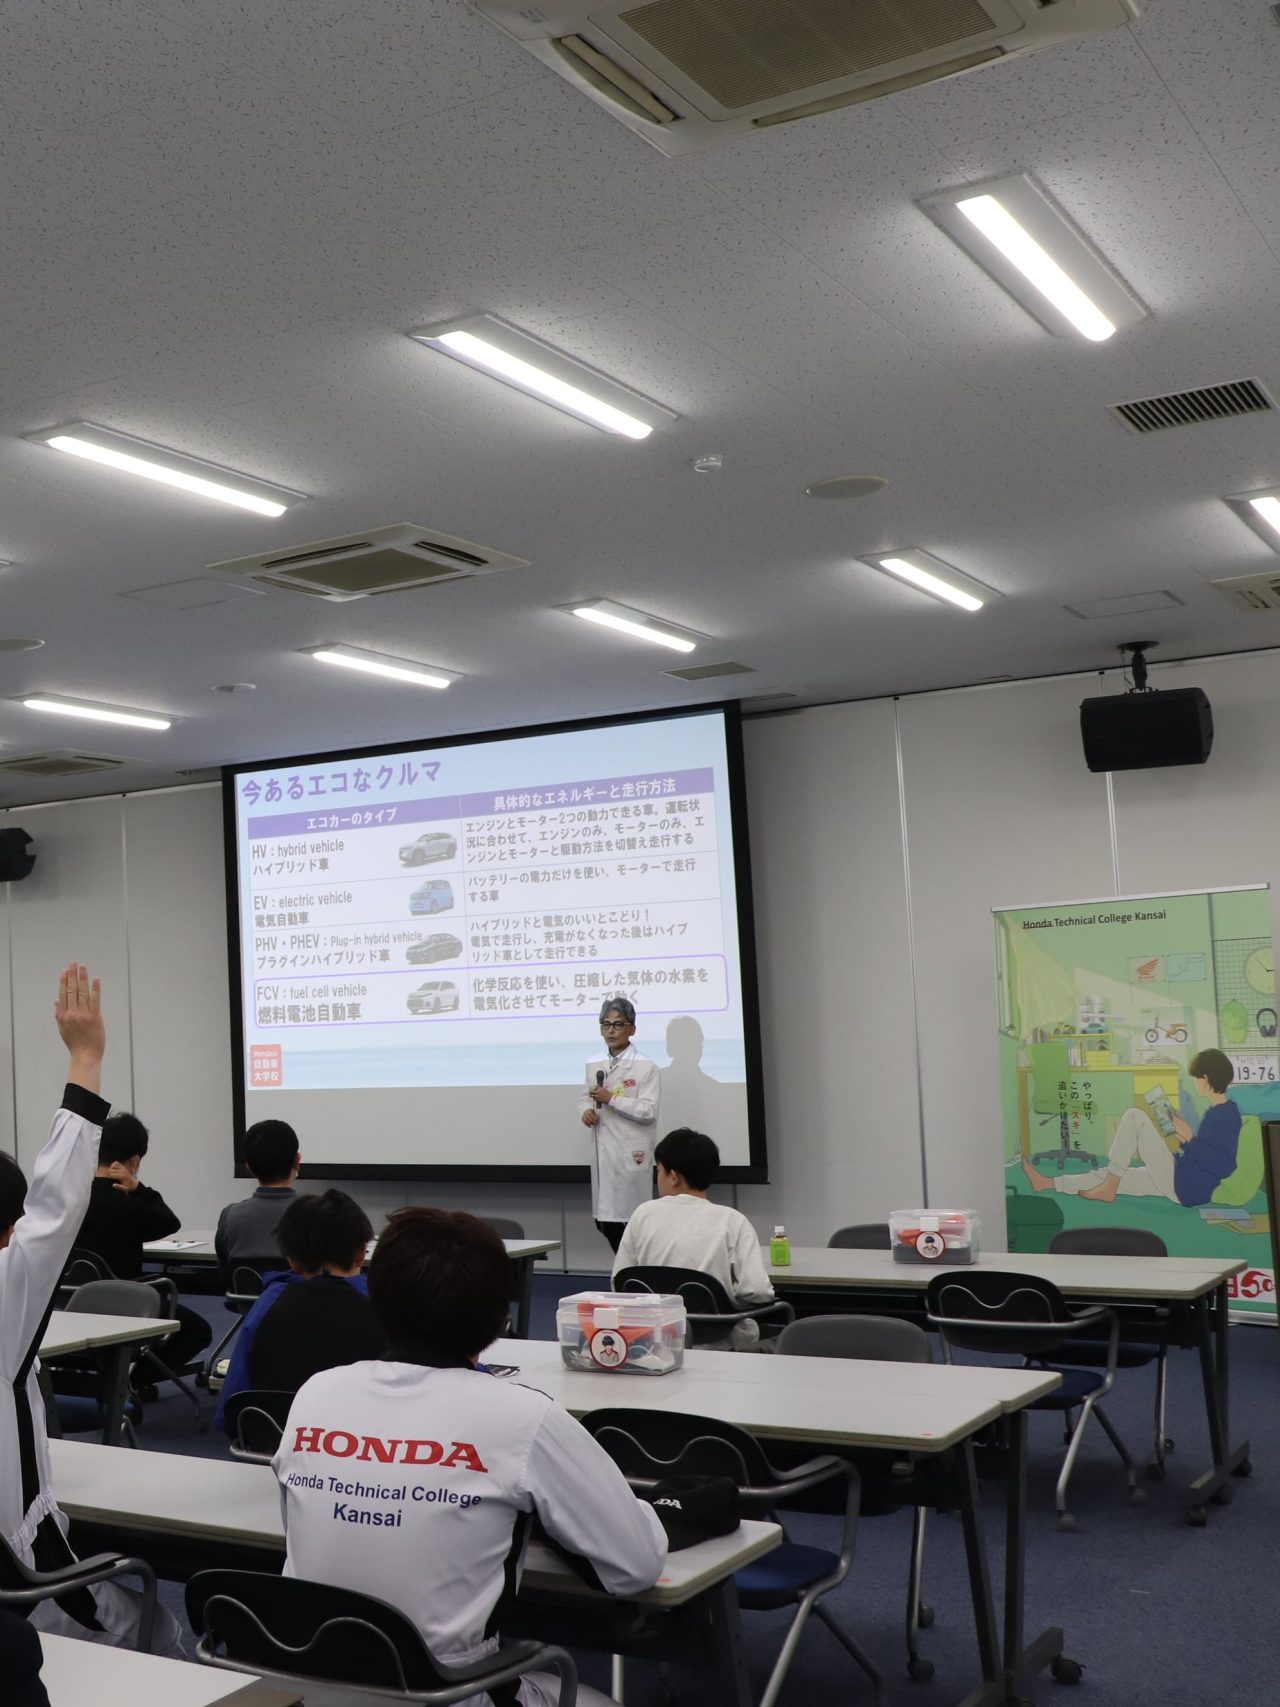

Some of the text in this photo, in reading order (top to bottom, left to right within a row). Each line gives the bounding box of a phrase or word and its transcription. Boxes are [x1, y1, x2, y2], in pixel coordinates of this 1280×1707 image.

[242, 761, 441, 806] 今あるエコなクルマ
[493, 777, 677, 812] 具体的なエネルギーと走行方法
[306, 807, 398, 830] エコカーのタイプ
[310, 839, 345, 855] vehicle
[253, 857, 330, 876] ハイブリッド車
[469, 858, 697, 888] バッテリーの電力だけを使い、モーターで走行
[318, 891, 353, 905] vehicle
[469, 889, 500, 903] する車
[255, 911, 309, 928] 電気自動車
[1023, 909, 1166, 929] Honda Technical College Kansai
[364, 931, 390, 946] hybrid
[393, 930, 422, 943] vehicle
[471, 922, 688, 948] 電気で走行し、充電がなくなった後はハイブ
[256, 949, 391, 970] プラグインハイブリッド車
[472, 944, 598, 964] リッド車として走行できる
[311, 985, 329, 999] cell
[332, 983, 367, 997] vehicle
[473, 968, 709, 993] 化学反応を使い、圧縮した気体の水素を
[257, 1002, 362, 1025] 燃料電池自動車
[1237, 1066, 1275, 1081] 19-76
[293, 1426, 489, 1473] HONDA
[285, 1471, 483, 1509] Honda Technical College
[333, 1502, 403, 1528] Kansai
